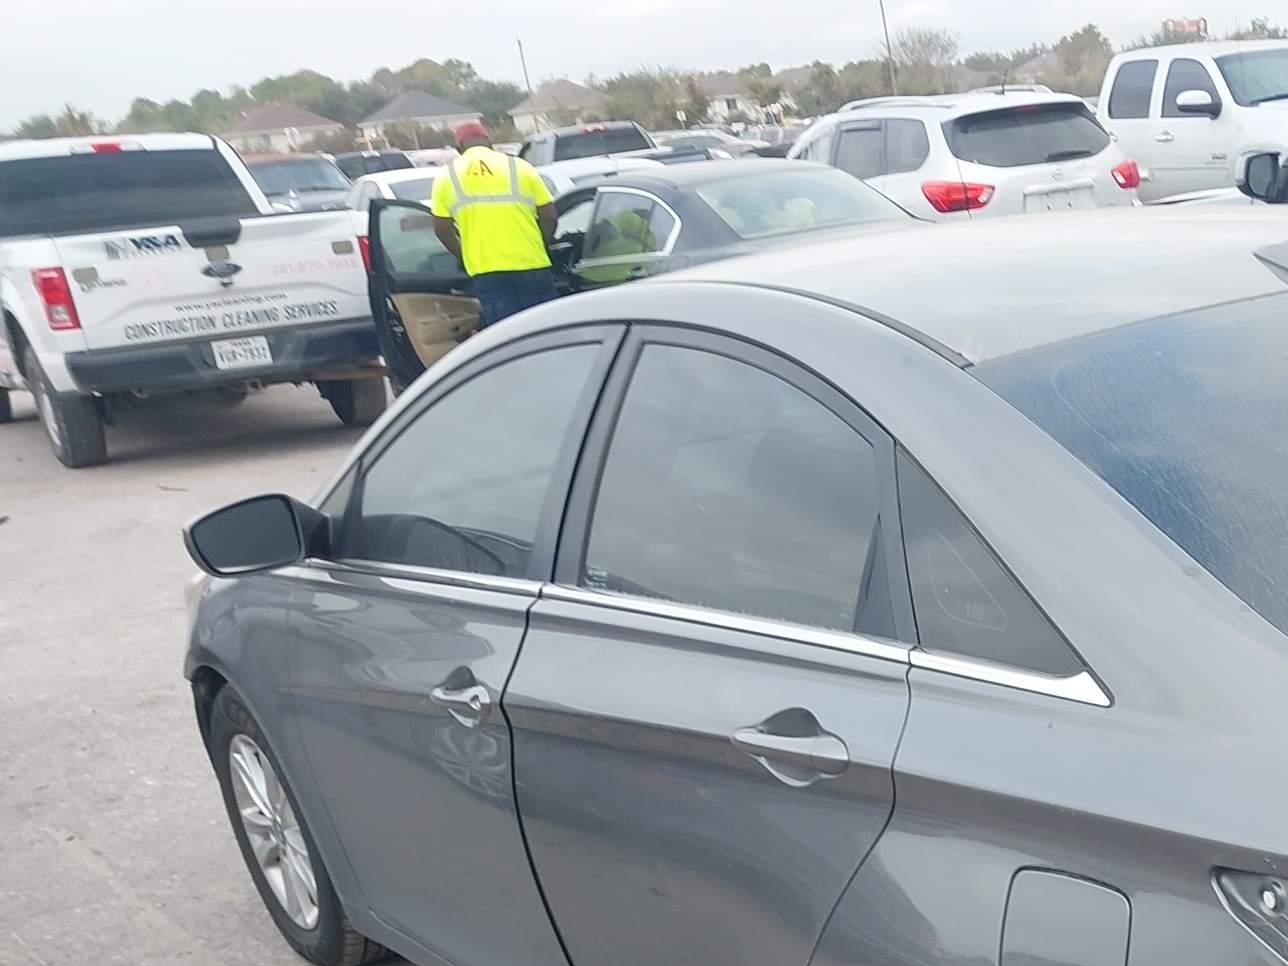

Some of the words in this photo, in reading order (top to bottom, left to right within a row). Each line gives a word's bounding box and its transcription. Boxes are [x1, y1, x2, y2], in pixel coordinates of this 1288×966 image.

[124, 315, 217, 340] CONSTRUCTION
[222, 306, 280, 329] CLEANING
[284, 299, 338, 321] SERVICES
